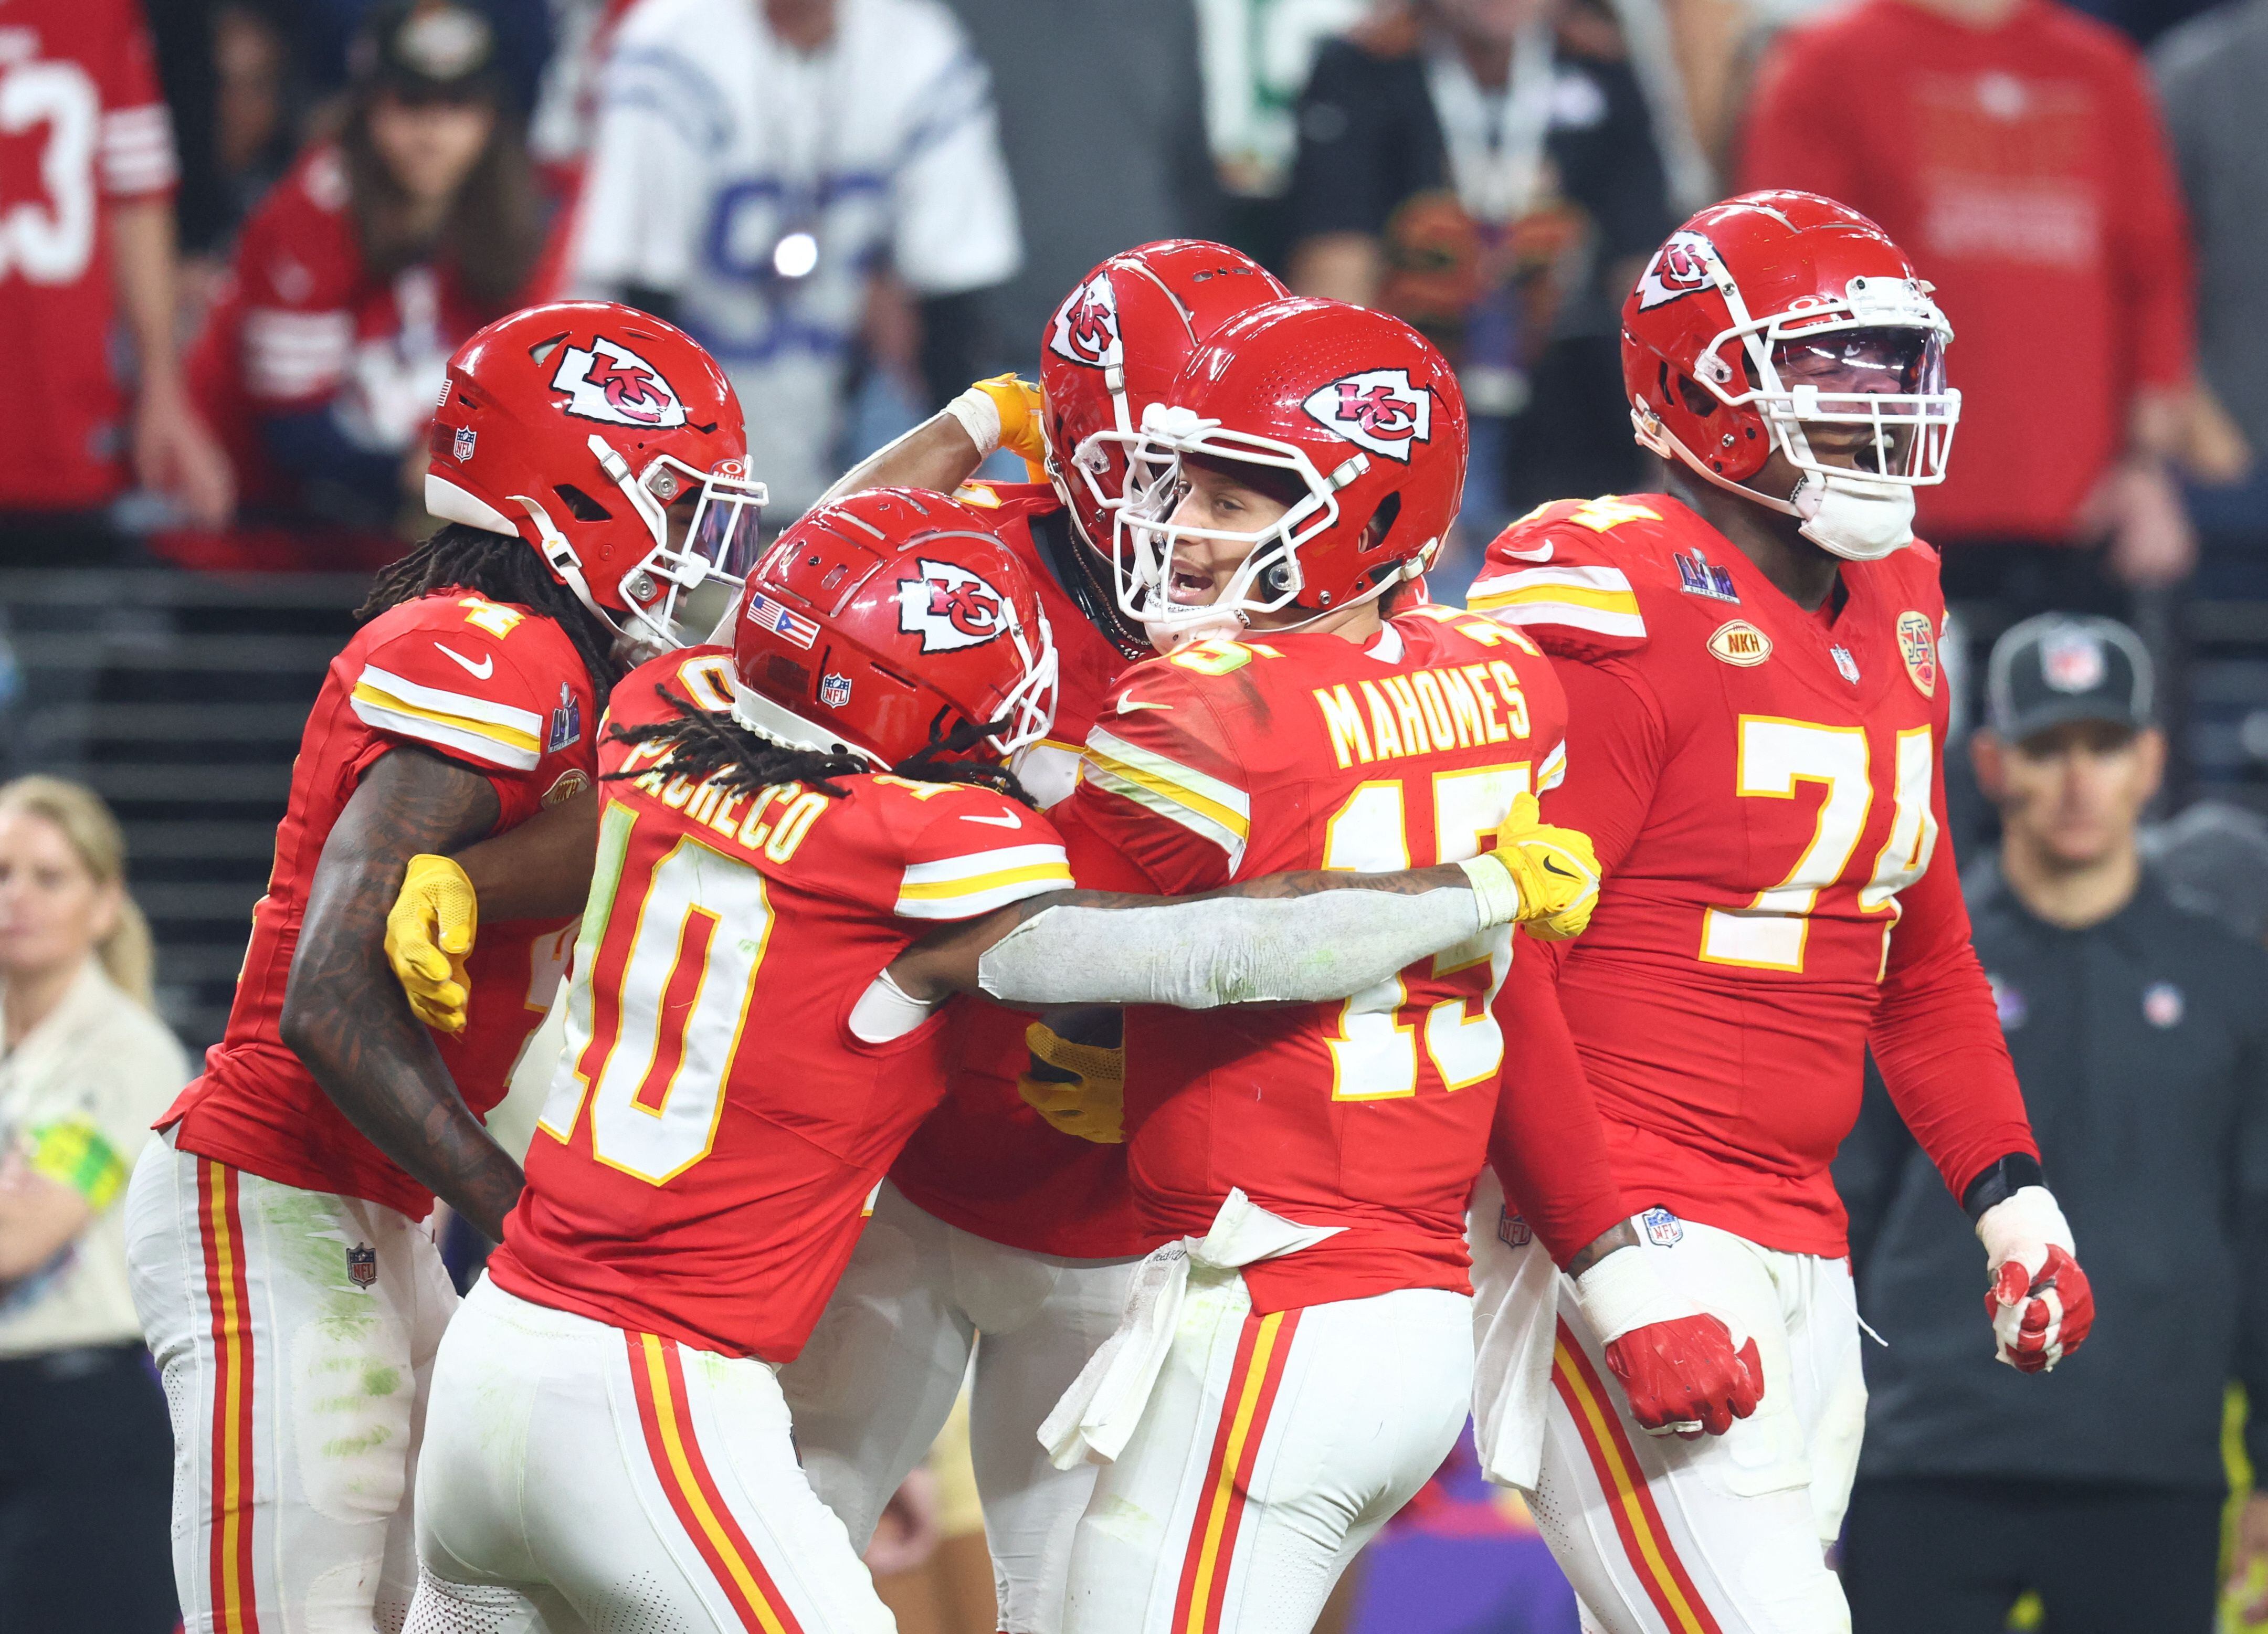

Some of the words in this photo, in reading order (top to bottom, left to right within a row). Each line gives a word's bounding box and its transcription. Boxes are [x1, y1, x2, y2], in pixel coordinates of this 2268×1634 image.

[582, 352, 671, 423] KC
[1334, 383, 1417, 441] KC
[456, 441, 470, 456] NFL
[925, 578, 999, 636] KC
[1727, 633, 1760, 653] NKH
[825, 688, 845, 703] NFL
[1313, 660, 1532, 769] MAHOMES
[1699, 713, 1939, 988] 74
[1321, 761, 1533, 1102] 15
[537, 797, 776, 1187] 10
[1503, 1220, 1528, 1243] NFL
[1652, 1223, 1678, 1239] NFL
[353, 1263, 373, 1281] NFL
